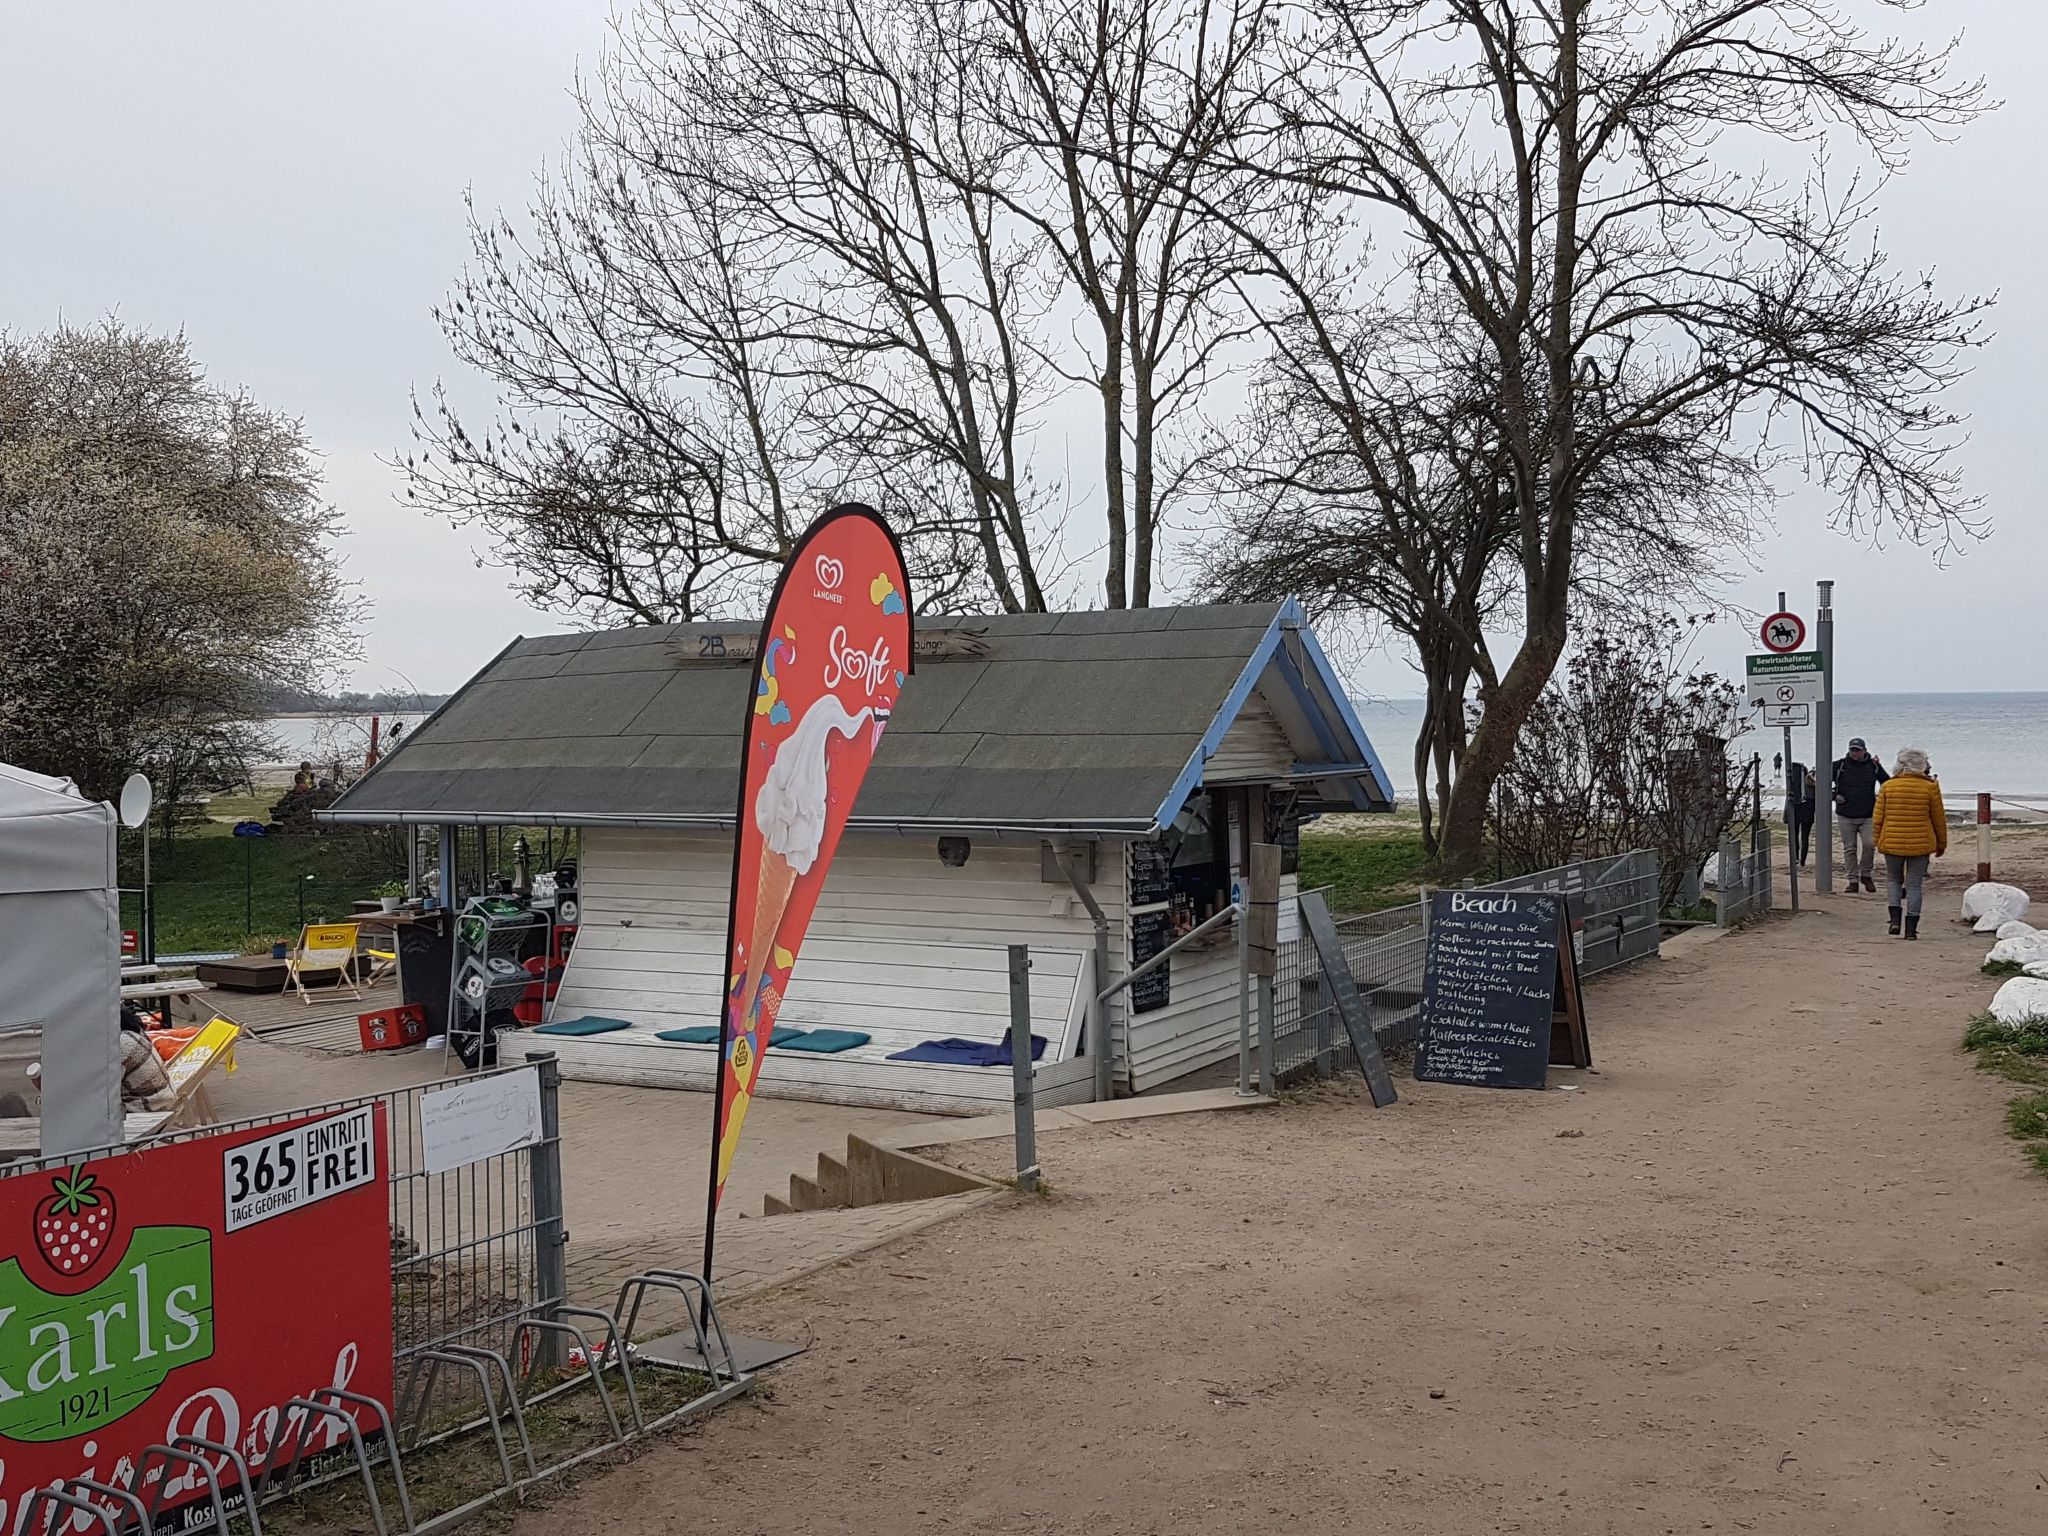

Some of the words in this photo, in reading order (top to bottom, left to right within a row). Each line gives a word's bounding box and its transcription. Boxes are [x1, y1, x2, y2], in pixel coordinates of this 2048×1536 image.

[813, 588, 843, 604] LANGNESE
[914, 640, 944, 654] ounge
[1752, 663, 1817, 674] Naturstrandbereich
[1756, 655, 1812, 665] Bewirtschafteter
[1452, 892, 1517, 914] Beach
[1491, 950, 1511, 959] mit
[1437, 965, 1508, 983] Fischbrötchen
[1491, 960, 1513, 971] mit
[1516, 962, 1539, 973] Brot
[1438, 988, 1486, 1006] Brathering
[1435, 999, 1484, 1016] Glühwein
[1431, 1014, 1476, 1028] Cocktails
[307, 1112, 367, 1158] EINTRITT
[231, 1138, 297, 1204] 365
[307, 1141, 369, 1197] FREI
[231, 1199, 254, 1224] TAGE
[255, 1186, 298, 1214] GEÖFFNET
[59, 1385, 110, 1427] 1921
